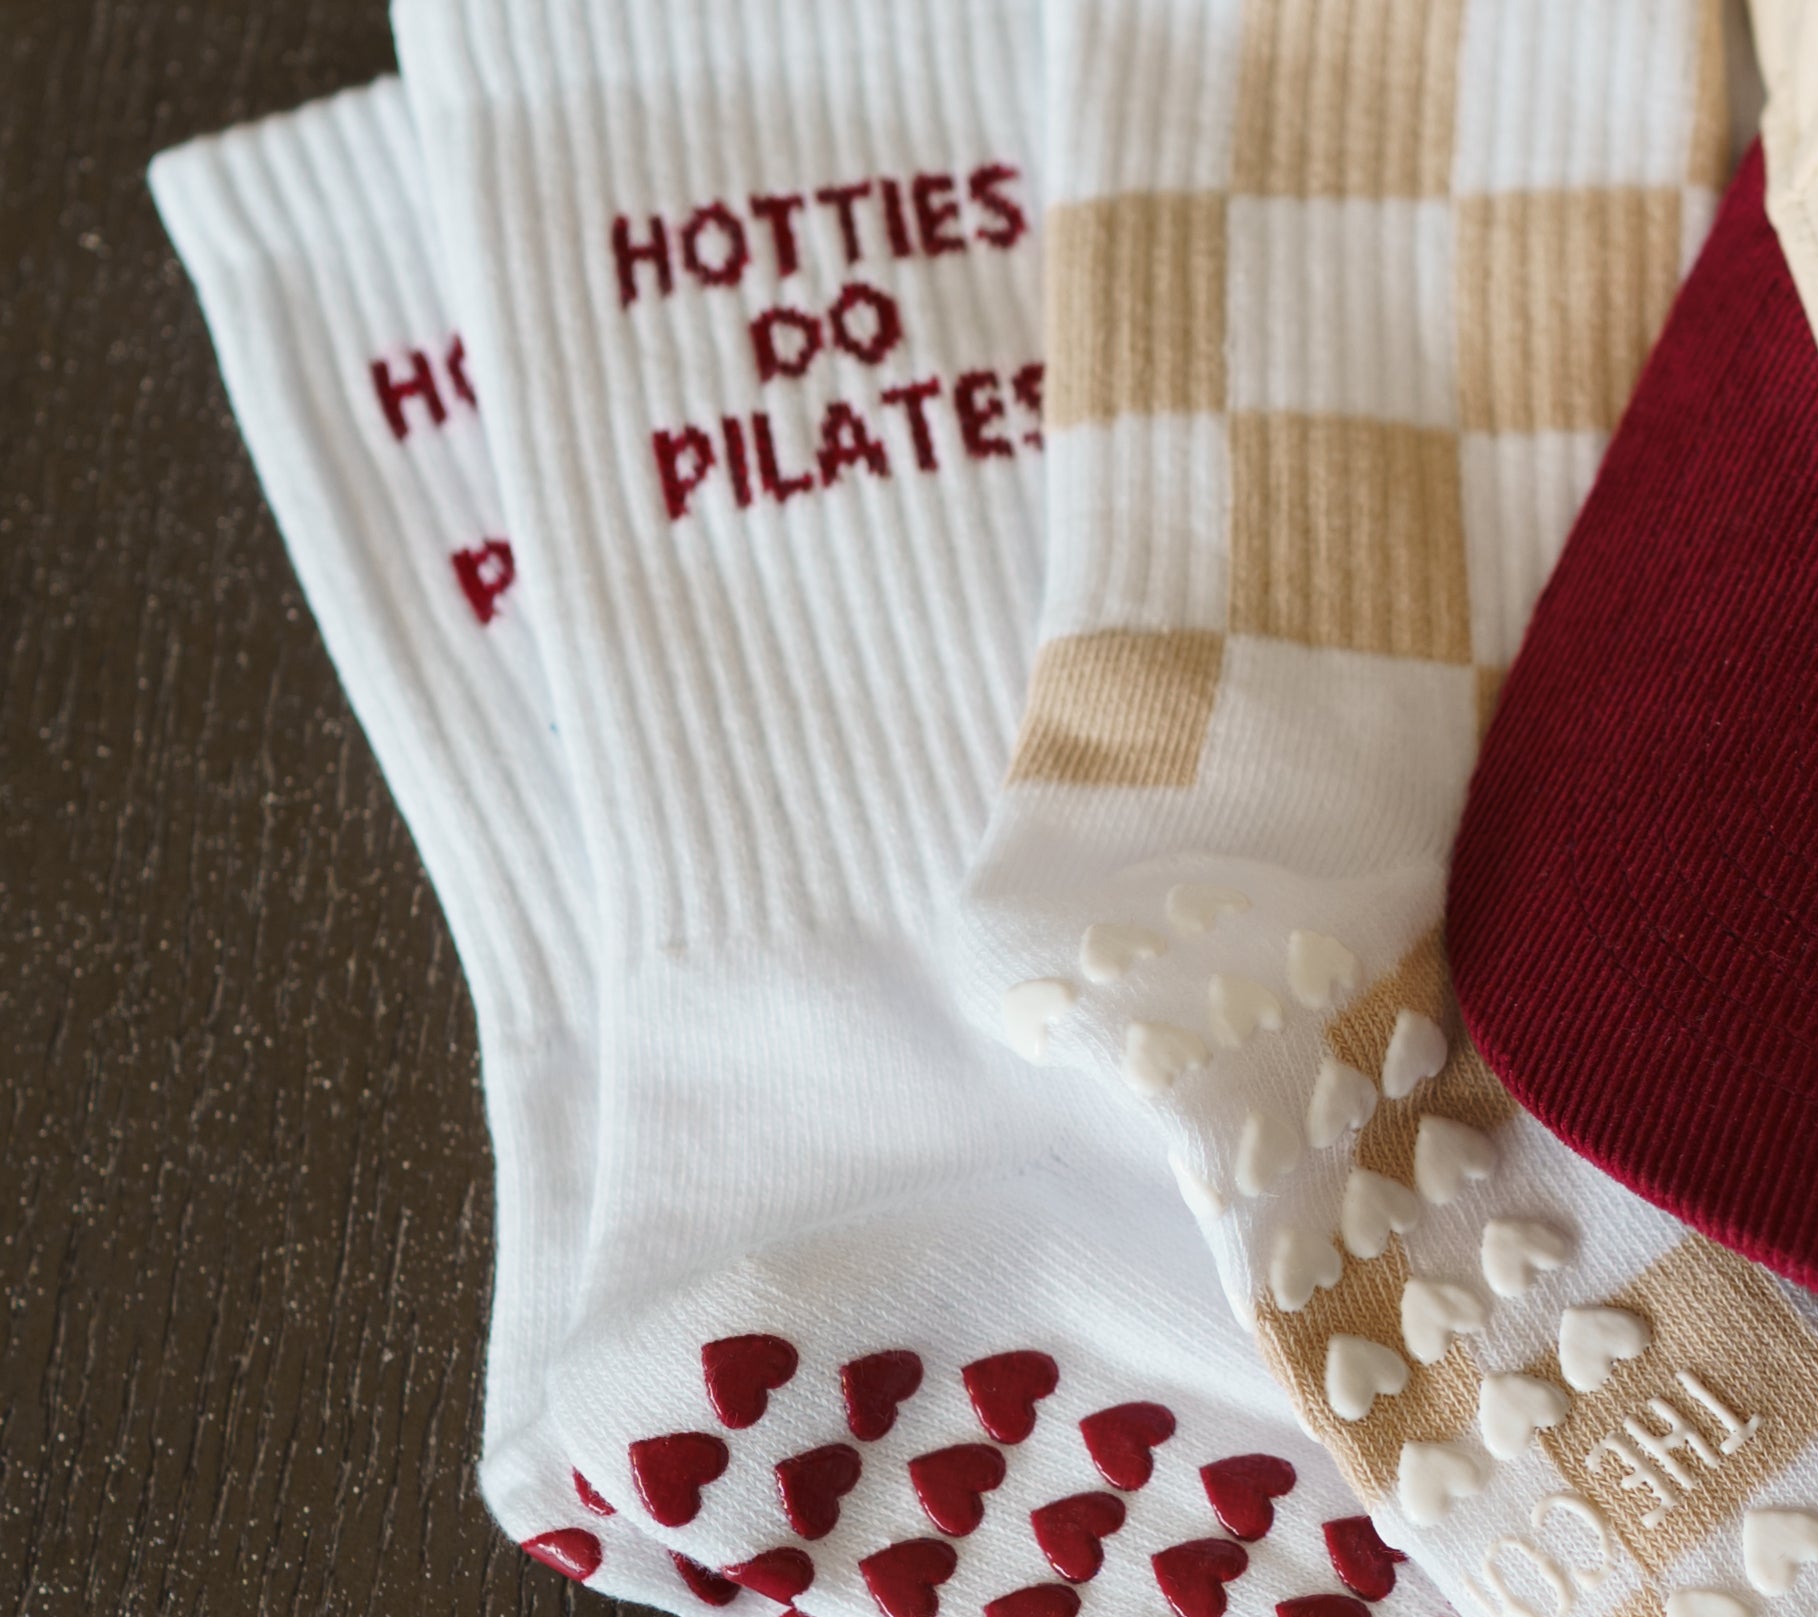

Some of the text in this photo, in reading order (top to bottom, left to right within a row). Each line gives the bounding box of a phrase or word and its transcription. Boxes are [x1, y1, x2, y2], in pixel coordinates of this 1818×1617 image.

[612, 163, 1029, 312] HOTTIES
[748, 282, 904, 385] DO
[1585, 1369, 1762, 1528] THE
